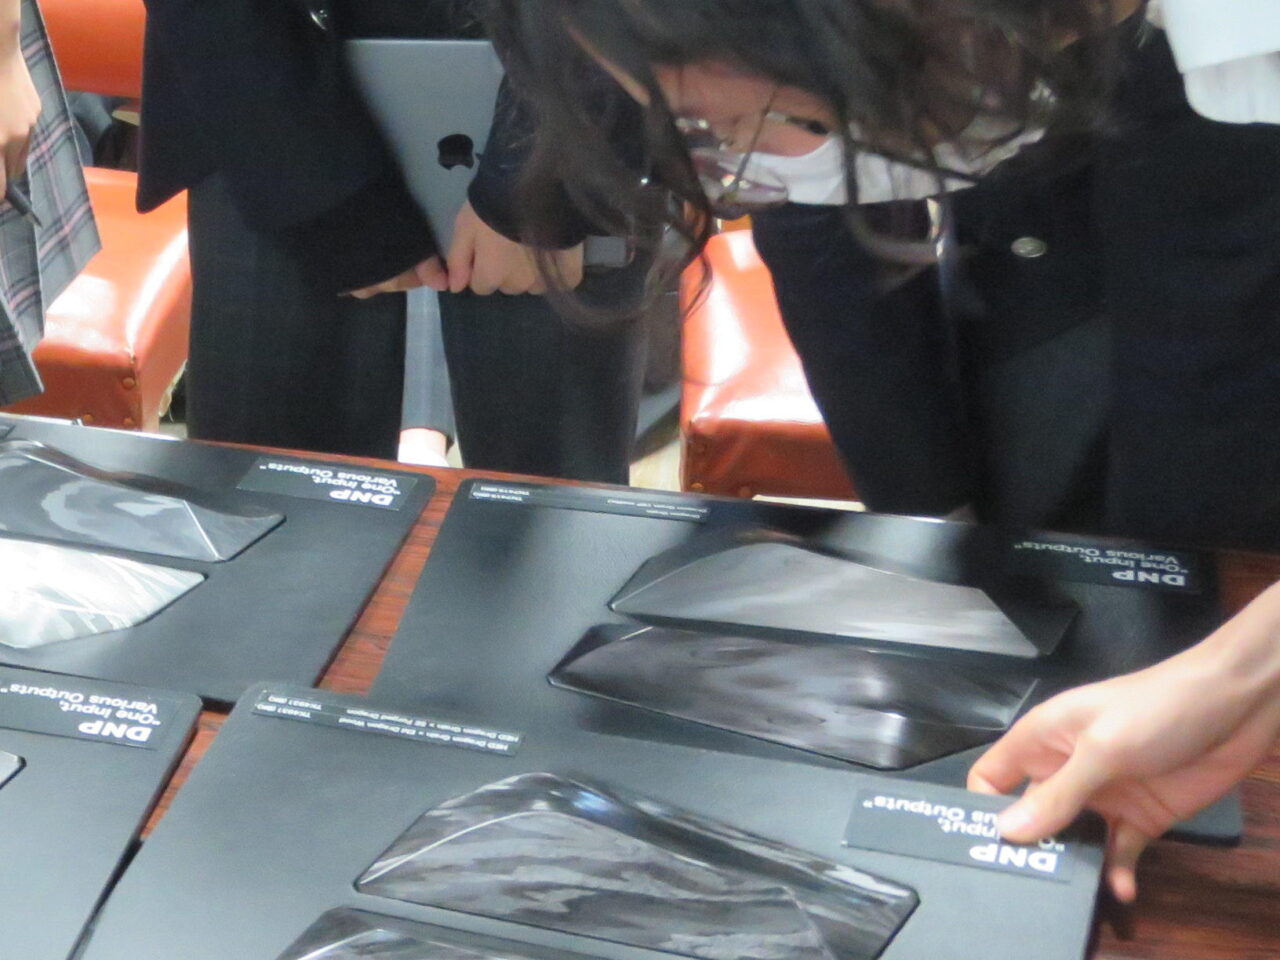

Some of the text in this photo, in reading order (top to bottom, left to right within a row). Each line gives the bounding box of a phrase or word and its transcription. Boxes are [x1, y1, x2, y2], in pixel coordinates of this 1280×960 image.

[259, 462, 398, 487] Various Outputs"
[329, 489, 394, 506] DNP
[1105, 549, 1180, 564] Various
[1111, 569, 1186, 586] DNP
[0, 683, 159, 714] Various Outputs"
[115, 710, 162, 726] "One
[78, 720, 152, 742] DNP
[862, 794, 966, 825] Outputs"
[969, 843, 1058, 873] DNP
